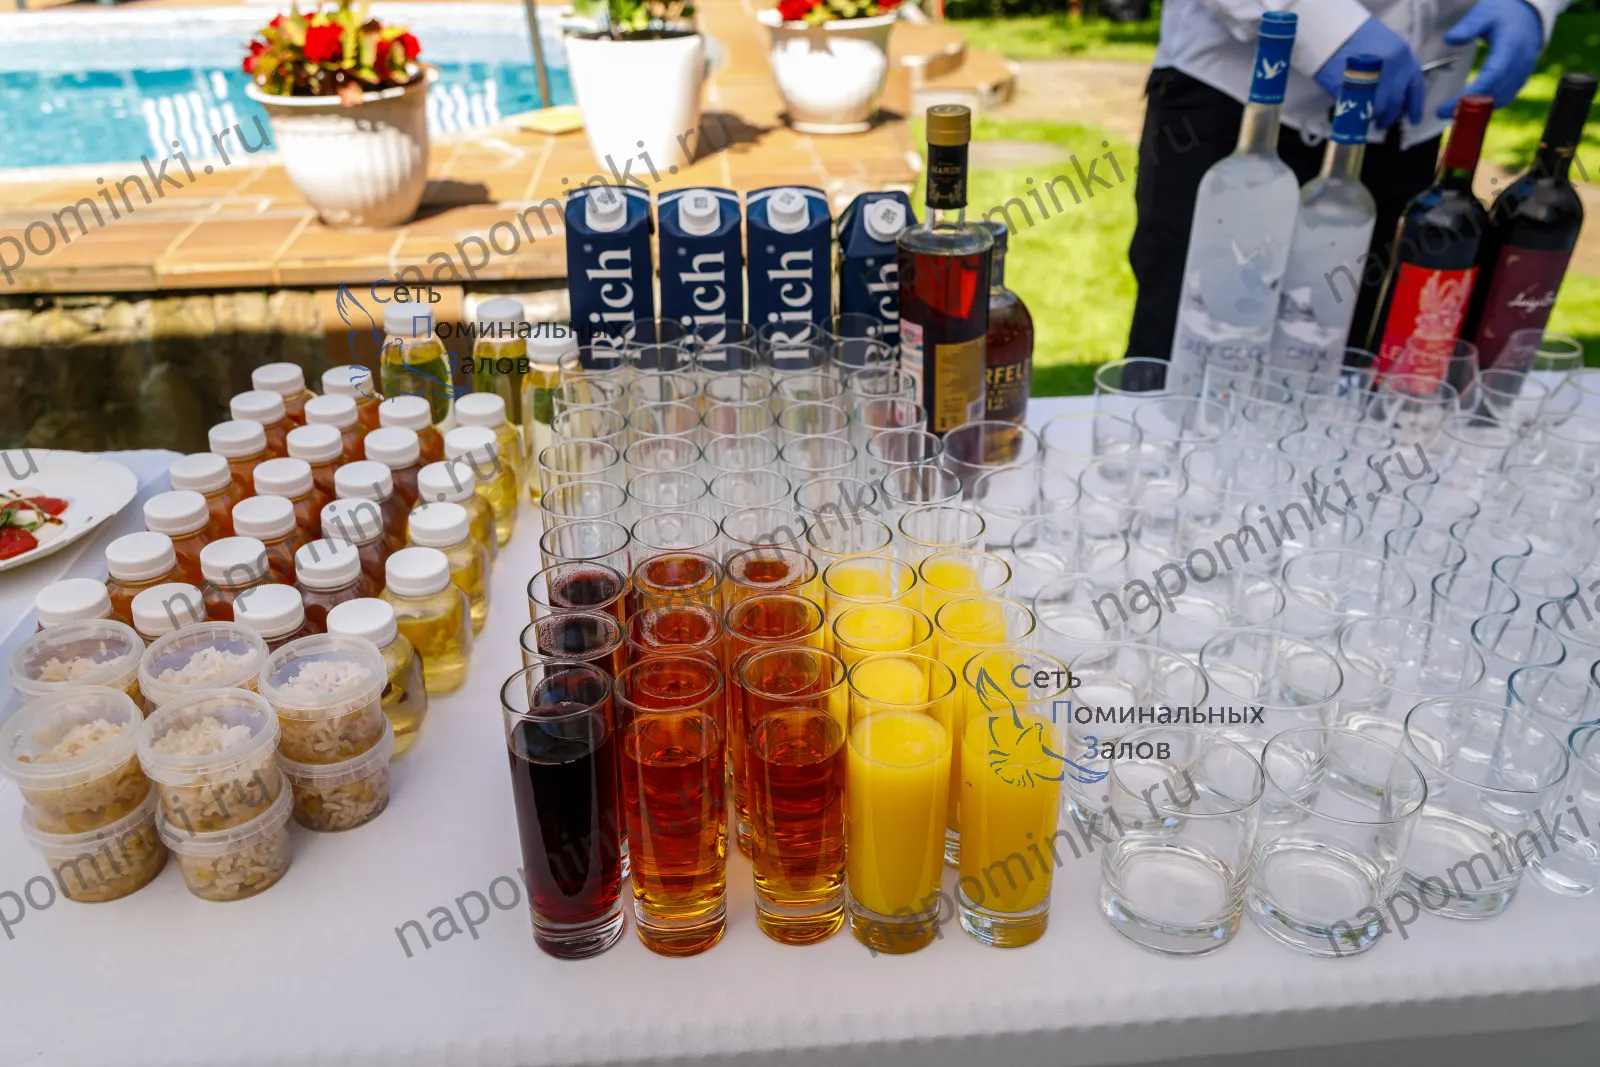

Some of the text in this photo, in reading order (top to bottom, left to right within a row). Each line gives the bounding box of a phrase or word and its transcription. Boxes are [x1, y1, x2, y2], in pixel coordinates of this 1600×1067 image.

[590, 247, 635, 361] Rich
[682, 250, 727, 362] Rich
[769, 248, 814, 360] Rich
